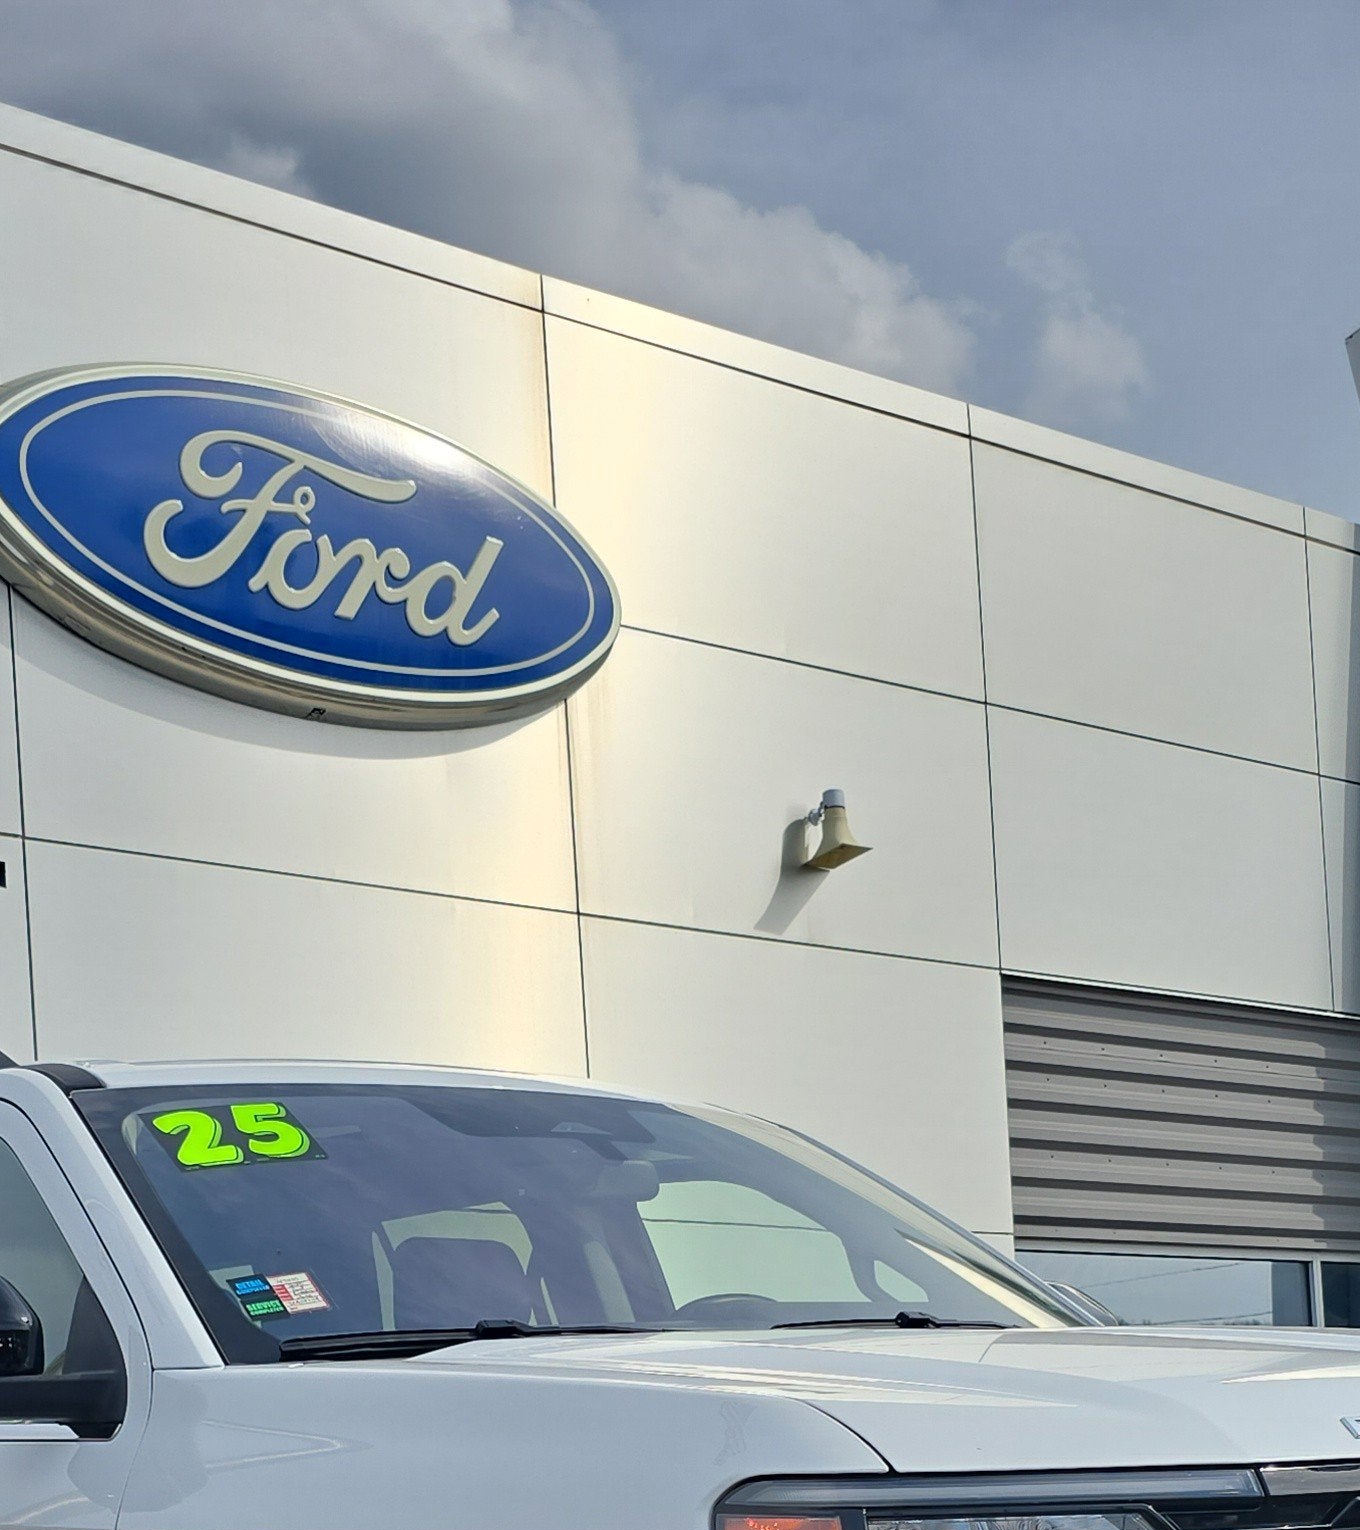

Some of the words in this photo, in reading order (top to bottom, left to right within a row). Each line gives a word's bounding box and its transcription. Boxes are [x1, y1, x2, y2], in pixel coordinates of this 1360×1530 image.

[143, 429, 505, 647] Ford
[152, 1102, 311, 1167] 25
[247, 1301, 281, 1311] SERVICE
